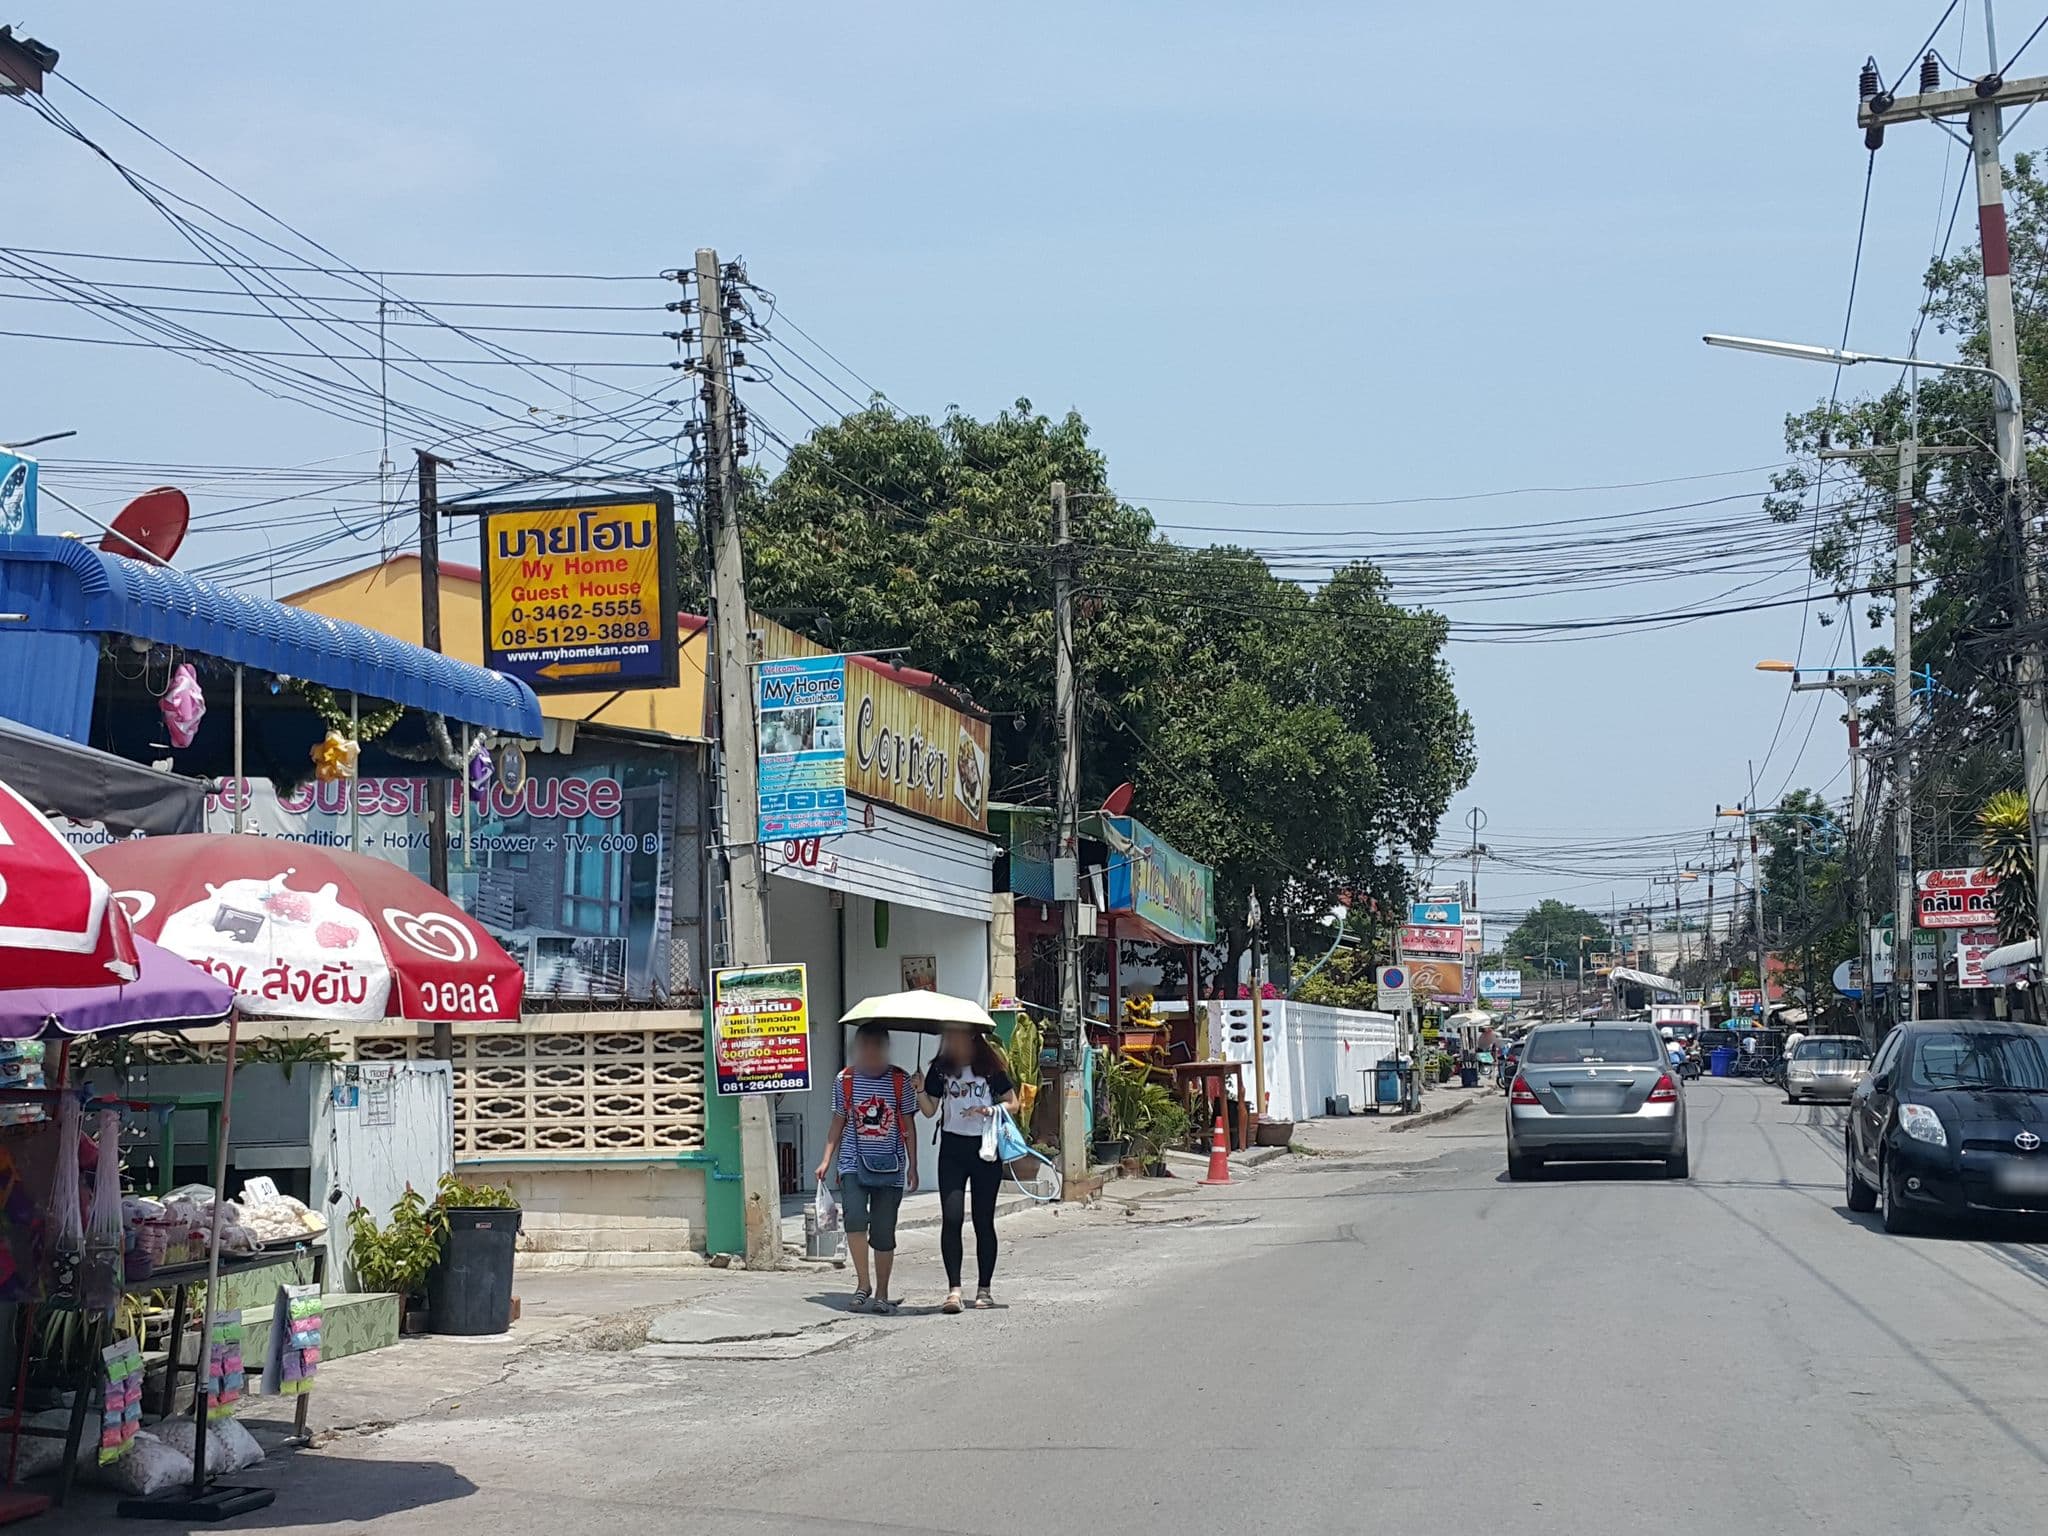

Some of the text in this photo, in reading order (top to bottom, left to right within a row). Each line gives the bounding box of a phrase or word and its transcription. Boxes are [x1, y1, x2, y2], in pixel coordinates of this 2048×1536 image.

[499, 512, 651, 559] มายโฮม
[522, 557, 628, 581] My Home
[511, 581, 641, 602] Guest House
[511, 600, 642, 623] 0-3462-5555
[501, 621, 650, 646] 08-5129-3888
[507, 643, 649, 662] www.myhomekan.com
[856, 694, 949, 800] Corner
[470, 831, 537, 851] shower
[600, 833, 637, 851] 600
[420, 975, 499, 1013] วอลล์
[722, 1078, 804, 1092] 081-2640888
